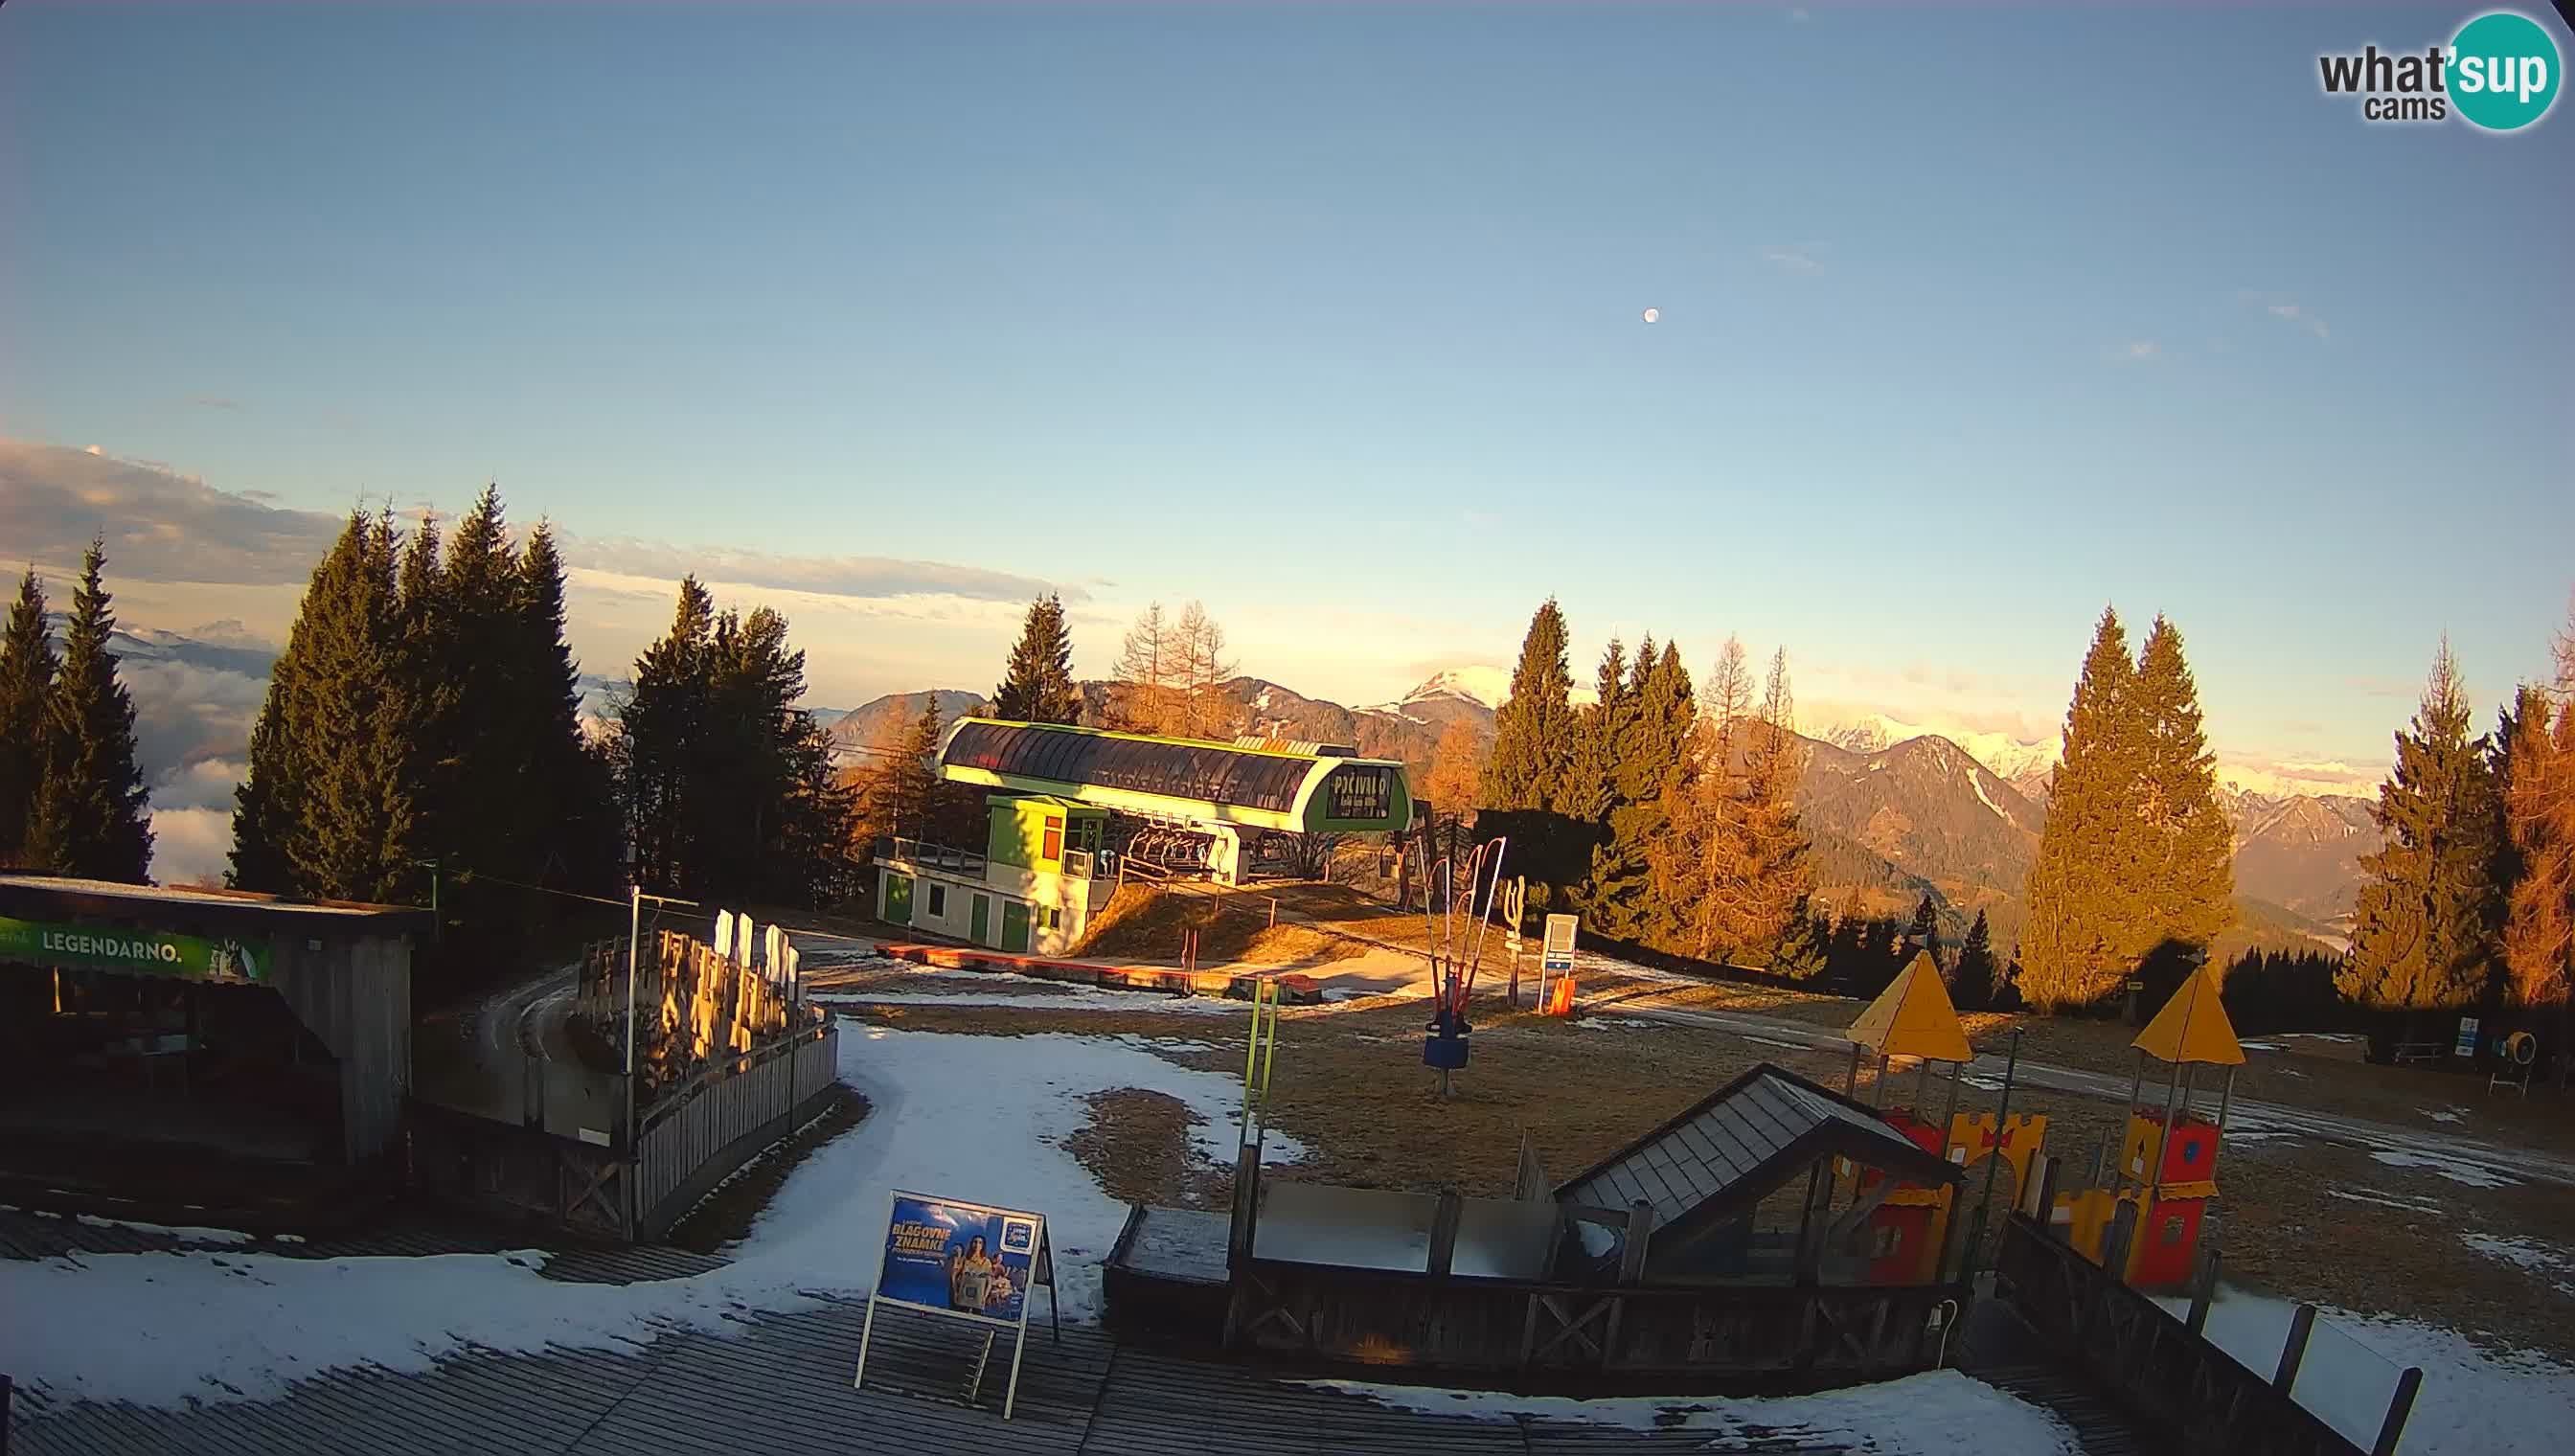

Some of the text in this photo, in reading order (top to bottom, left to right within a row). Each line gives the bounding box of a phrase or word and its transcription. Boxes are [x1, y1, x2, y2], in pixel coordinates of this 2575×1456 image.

[42, 931, 183, 964] LEGENDARNO.
[892, 1222, 951, 1241] BLAGOVNE
[895, 1236, 946, 1251] ZNAMKE
